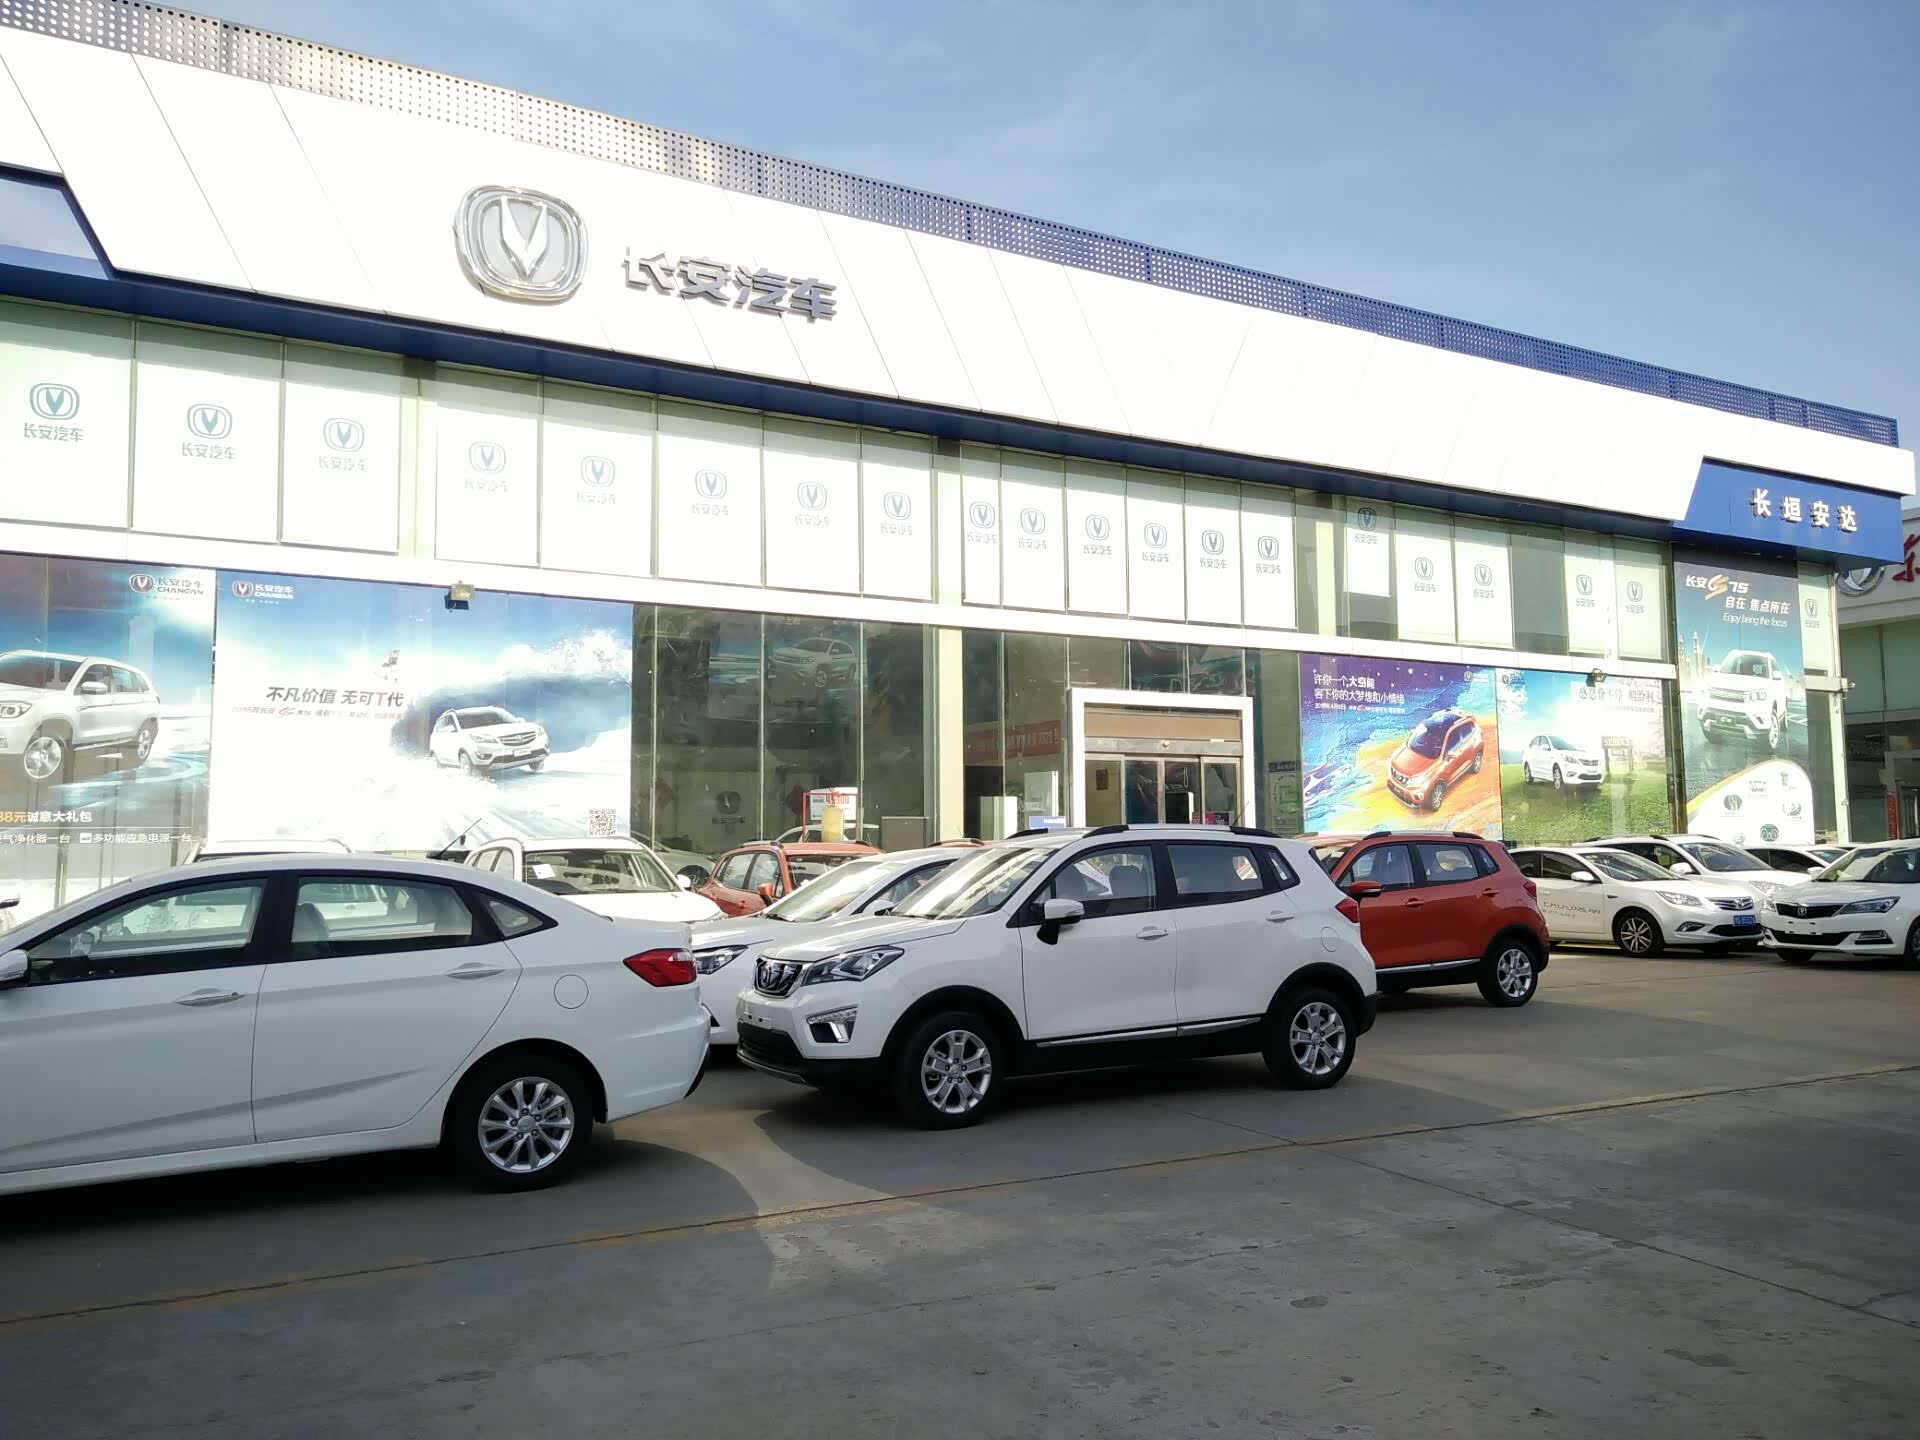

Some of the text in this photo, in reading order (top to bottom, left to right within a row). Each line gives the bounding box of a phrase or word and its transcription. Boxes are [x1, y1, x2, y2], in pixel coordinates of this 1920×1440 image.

[623, 247, 837, 322] 长安汽车
[23, 423, 84, 443] 长安汽车
[181, 441, 237, 461] 长安汽车
[1752, 488, 1858, 532] 长垣安达
[157, 586, 204, 595] CHANGAN
[1725, 596, 1791, 615] 自在 焦点所在
[1723, 612, 1788, 628] Enjoy being the focus
[266, 686, 404, 708] 不凡价值 无可T代
[93, 833, 192, 844] 多功能应急电源一台
